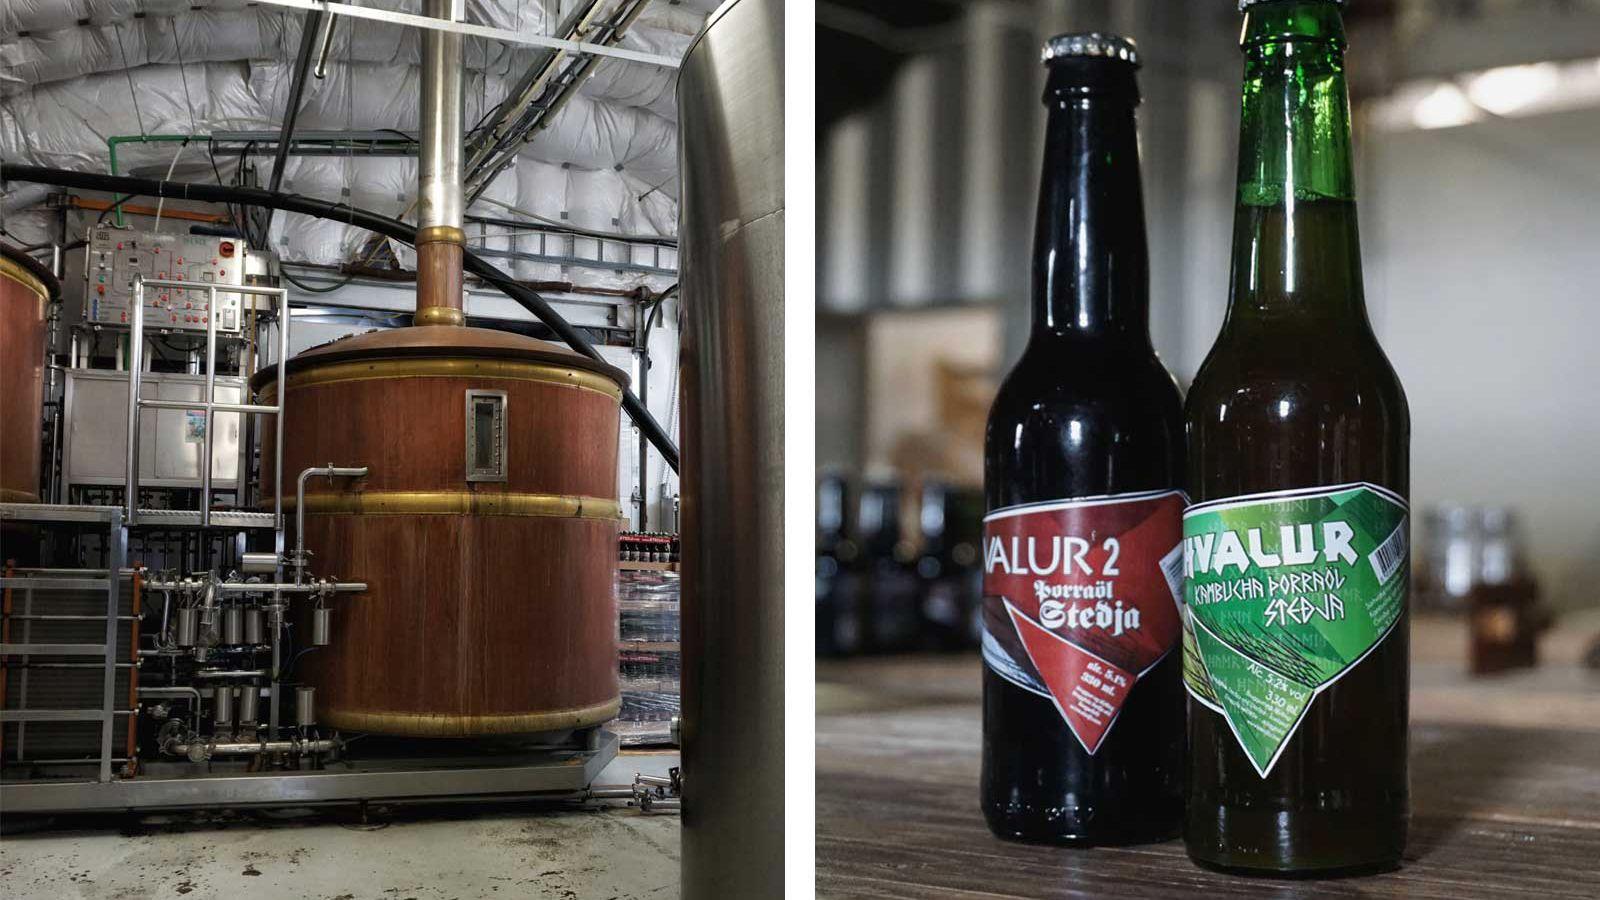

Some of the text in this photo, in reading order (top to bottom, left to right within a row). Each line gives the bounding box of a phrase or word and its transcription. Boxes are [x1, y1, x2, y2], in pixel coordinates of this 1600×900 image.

[1102, 536, 1121, 577] 2
[1183, 521, 1358, 579] HVALUR
[1194, 577, 1264, 606] KAMBUCHA
